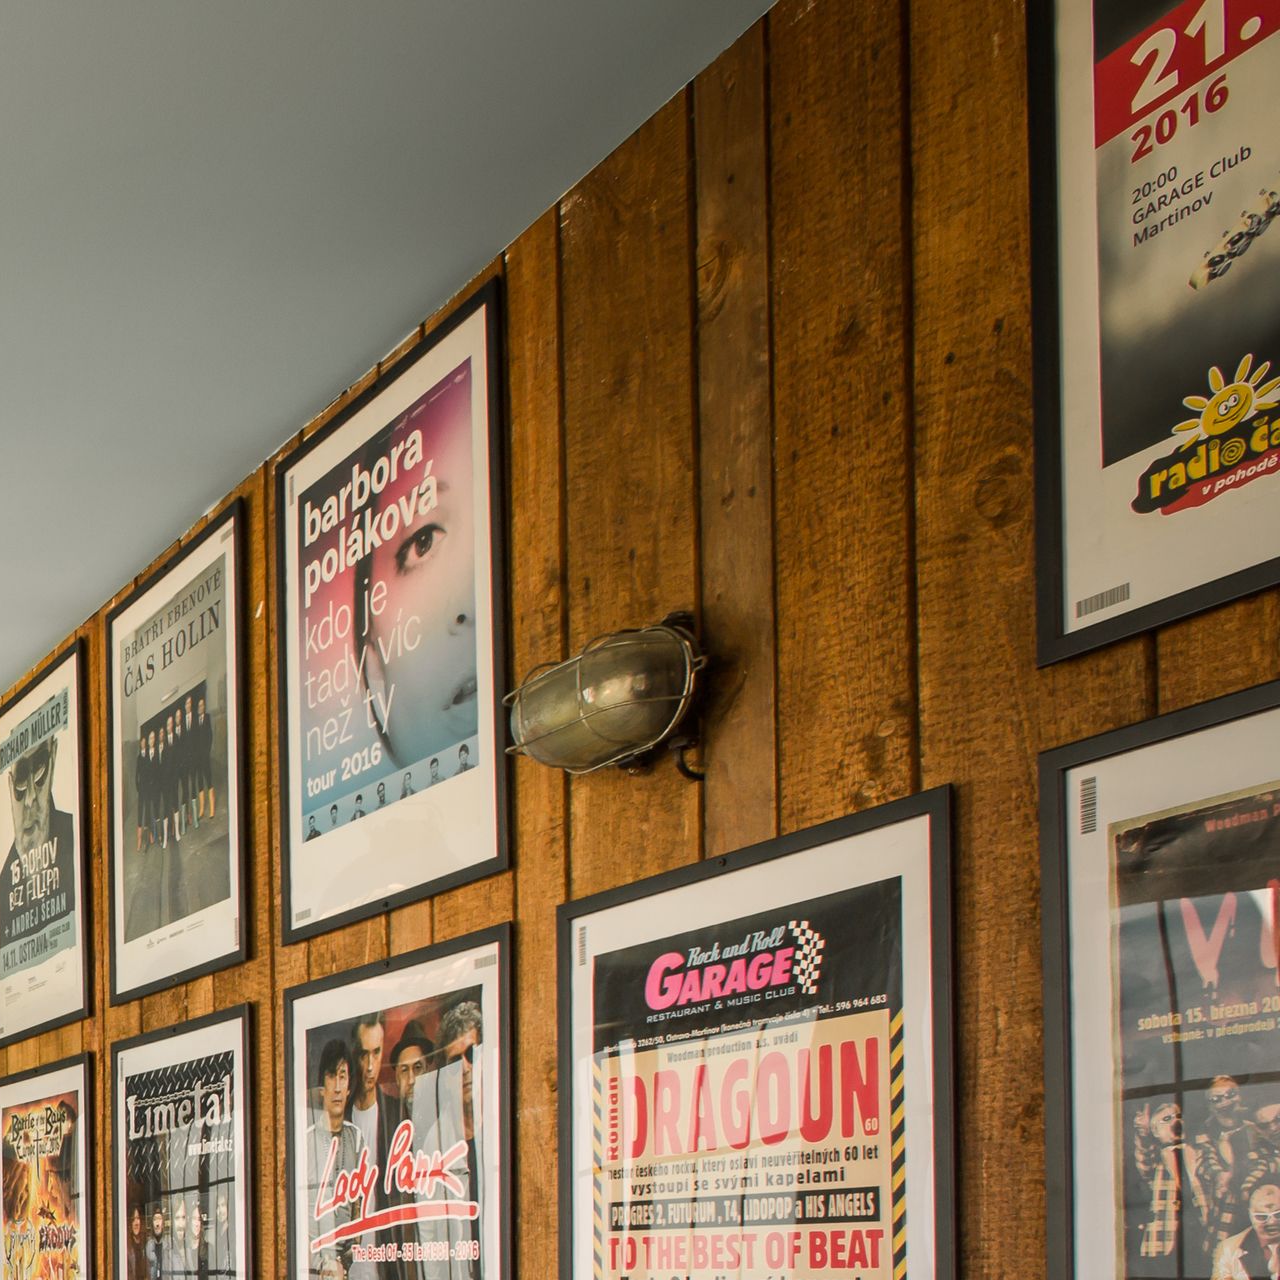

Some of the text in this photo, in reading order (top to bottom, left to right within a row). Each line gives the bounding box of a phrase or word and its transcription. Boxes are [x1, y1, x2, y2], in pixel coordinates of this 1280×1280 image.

[1130, 0, 1261, 114] 21.
[1131, 74, 1229, 164] 2016
[1132, 146, 1252, 225] GARAGE Club
[1132, 166, 1177, 205] 20:00
[1133, 191, 1213, 247] Martinov
[305, 429, 423, 547] barbora
[1151, 438, 1246, 499] radio
[1201, 453, 1278, 495] v pohodě
[305, 459, 438, 609] poláková
[124, 567, 221, 663] BRATŘI EBENOVÉ
[305, 578, 388, 660] kdo je
[124, 600, 222, 697] ČAS HOLIN
[305, 608, 421, 710] tady víc
[0, 728, 29, 769] RICHARD
[31, 702, 60, 744] MÜLLER
[307, 683, 395, 761] než ty
[307, 742, 382, 798] tour 2016
[9, 885, 24, 911] BEZ
[10, 859, 20, 885] 15
[11, 890, 67, 937] ANDREJ ŠEBAN
[19, 933, 48, 965] OSTRAVA
[686, 925, 786, 968] Rock and Roll
[644, 947, 795, 1010] GARAGE
[646, 986, 796, 1023] RESTAURANT & MUSIC CLUB
[836, 999, 851, 1011] 596
[853, 997, 868, 1008] 964
[871, 994, 887, 1006] 683
[1138, 1012, 1182, 1031] sobota
[1185, 1007, 1206, 1023] 15.
[707, 1040, 752, 1058] production
[607, 1077, 618, 1160] Roman
[622, 1037, 880, 1158] DRAGOUN
[864, 1117, 878, 1132] 60
[314, 1136, 378, 1220] Lady
[630, 1167, 845, 1196] vystoupí se svými kapelami
[635, 1162, 669, 1179] českého
[702, 1157, 726, 1175] který
[844, 1146, 859, 1161] 60
[862, 1145, 879, 1160] let
[743, 1196, 792, 1221] LIDOPOP
[805, 1195, 825, 1218] HIS
[828, 1192, 875, 1217] ANGELS
[351, 1240, 479, 1262] The Best Of 35 2016
[608, 1229, 884, 1270] TO THE BEST OF BEAT
